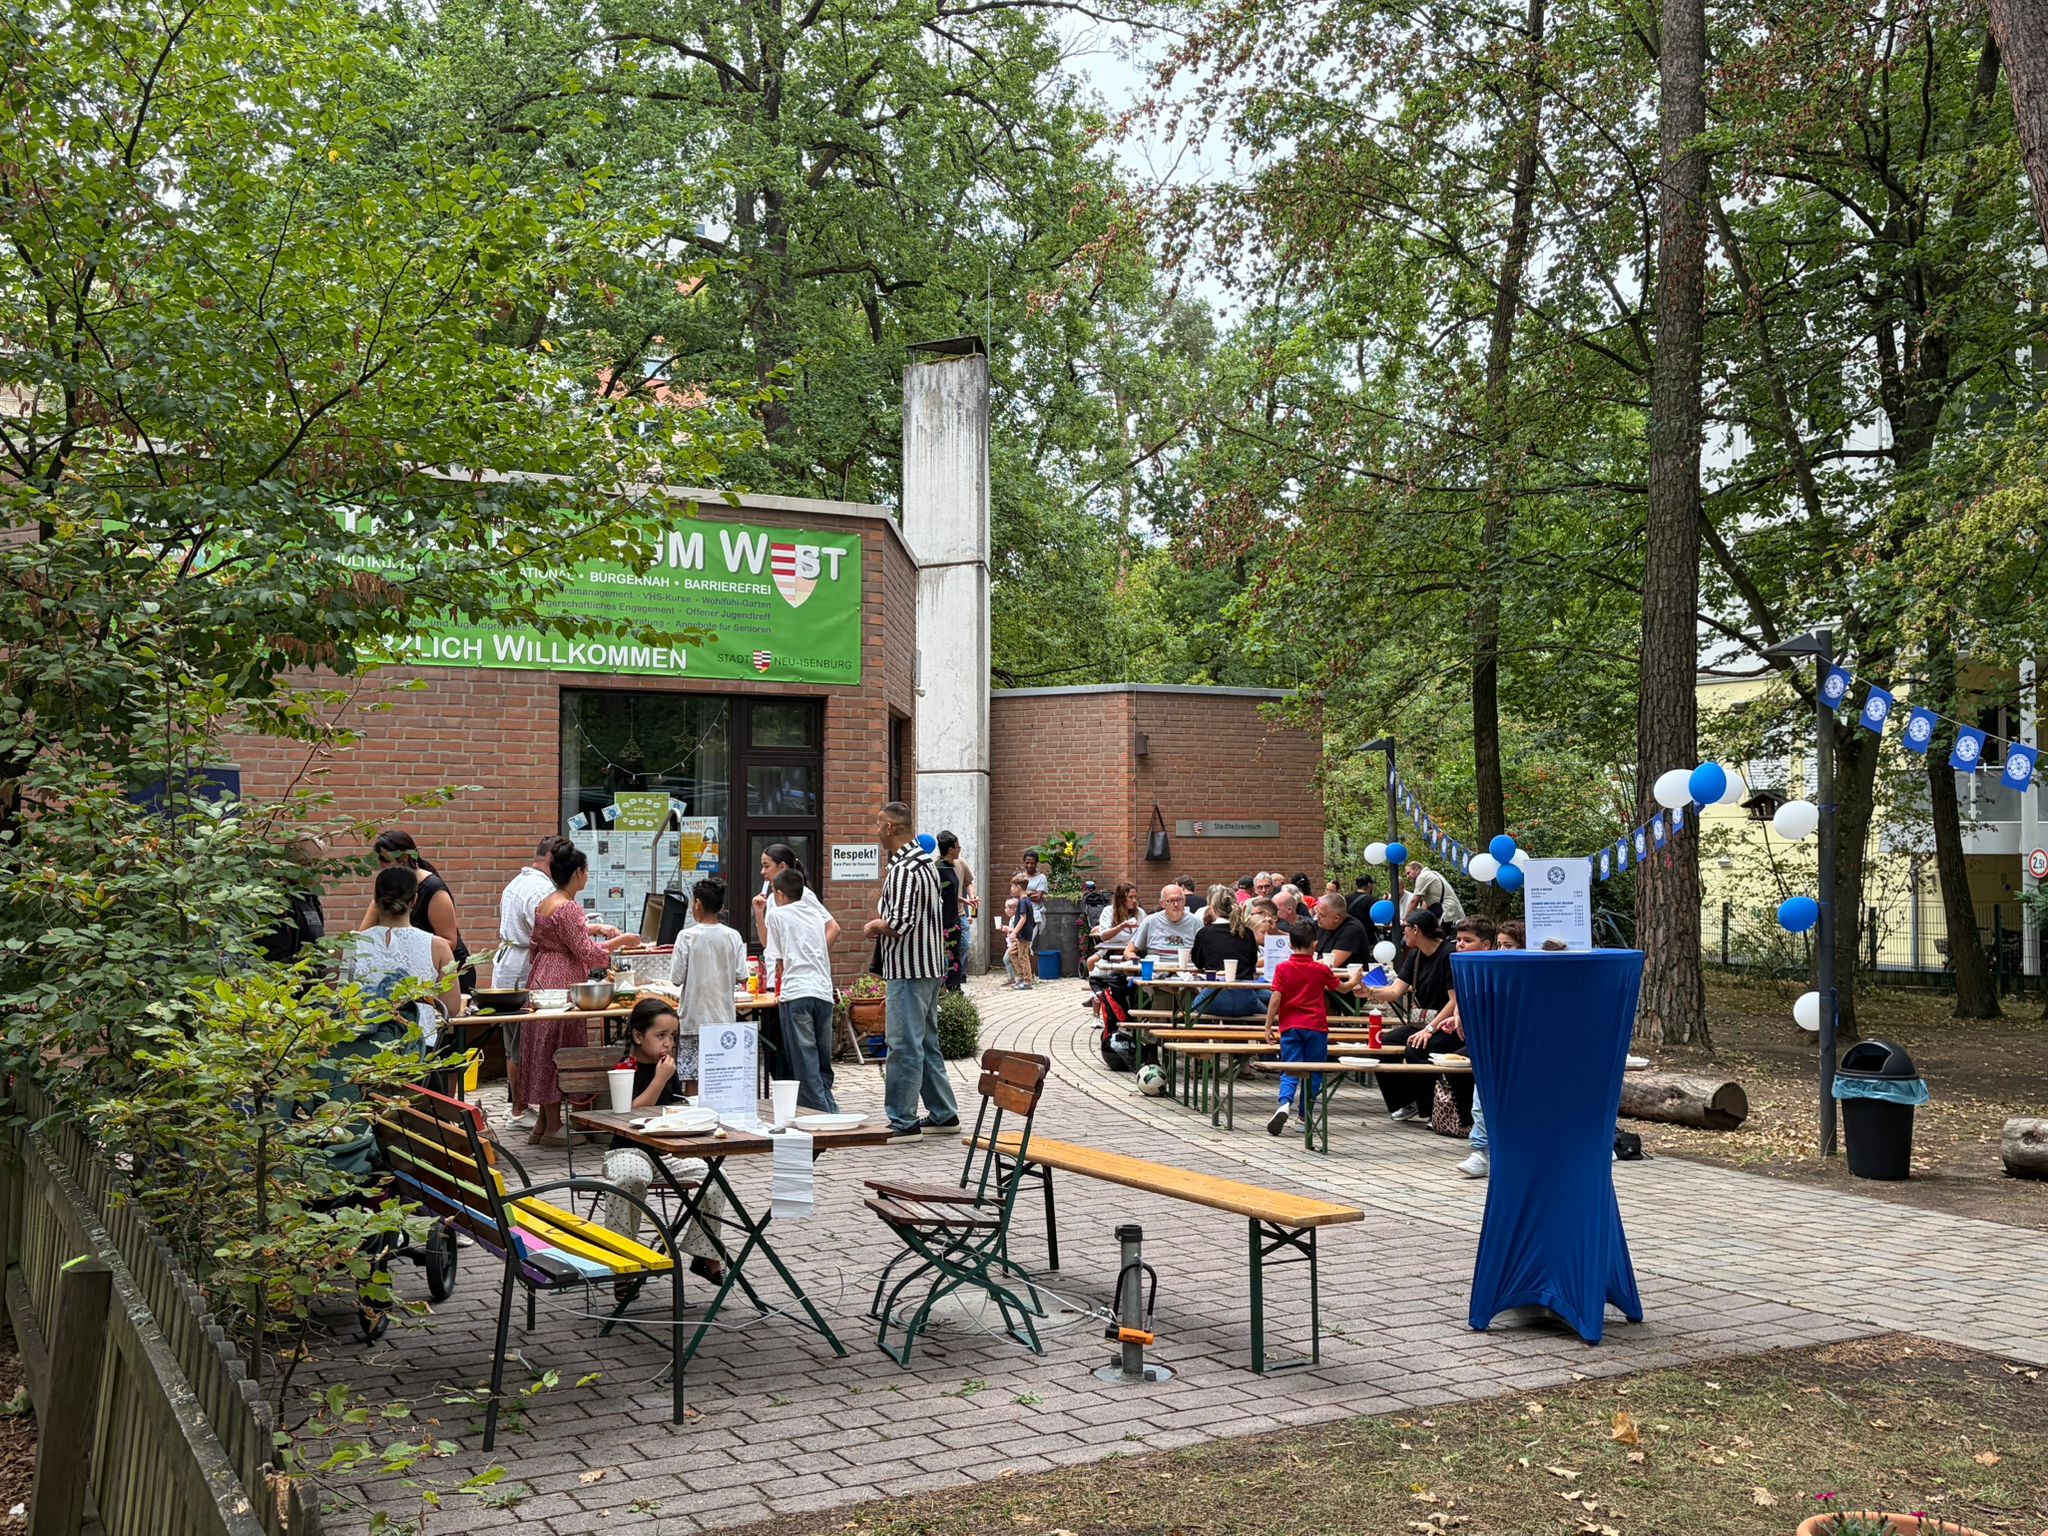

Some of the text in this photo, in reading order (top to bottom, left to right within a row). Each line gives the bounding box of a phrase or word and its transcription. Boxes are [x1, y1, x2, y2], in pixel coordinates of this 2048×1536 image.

[590, 570, 670, 588] BÜRGERNAH
[684, 578, 772, 595] BARRIEREFREI
[643, 592, 692, 603] VHS-Kurse
[702, 597, 772, 609] Wohlfühl-Garten
[619, 603, 675, 614] Engagement
[686, 607, 719, 617] Offener
[721, 611, 772, 621] Jugendtreff
[734, 624, 772, 634] Senioren
[492, 633, 688, 670] WILLKOMMEN
[717, 652, 853, 670] STADT NEU-ISENBURG
[833, 848, 877, 861] Respekt!
